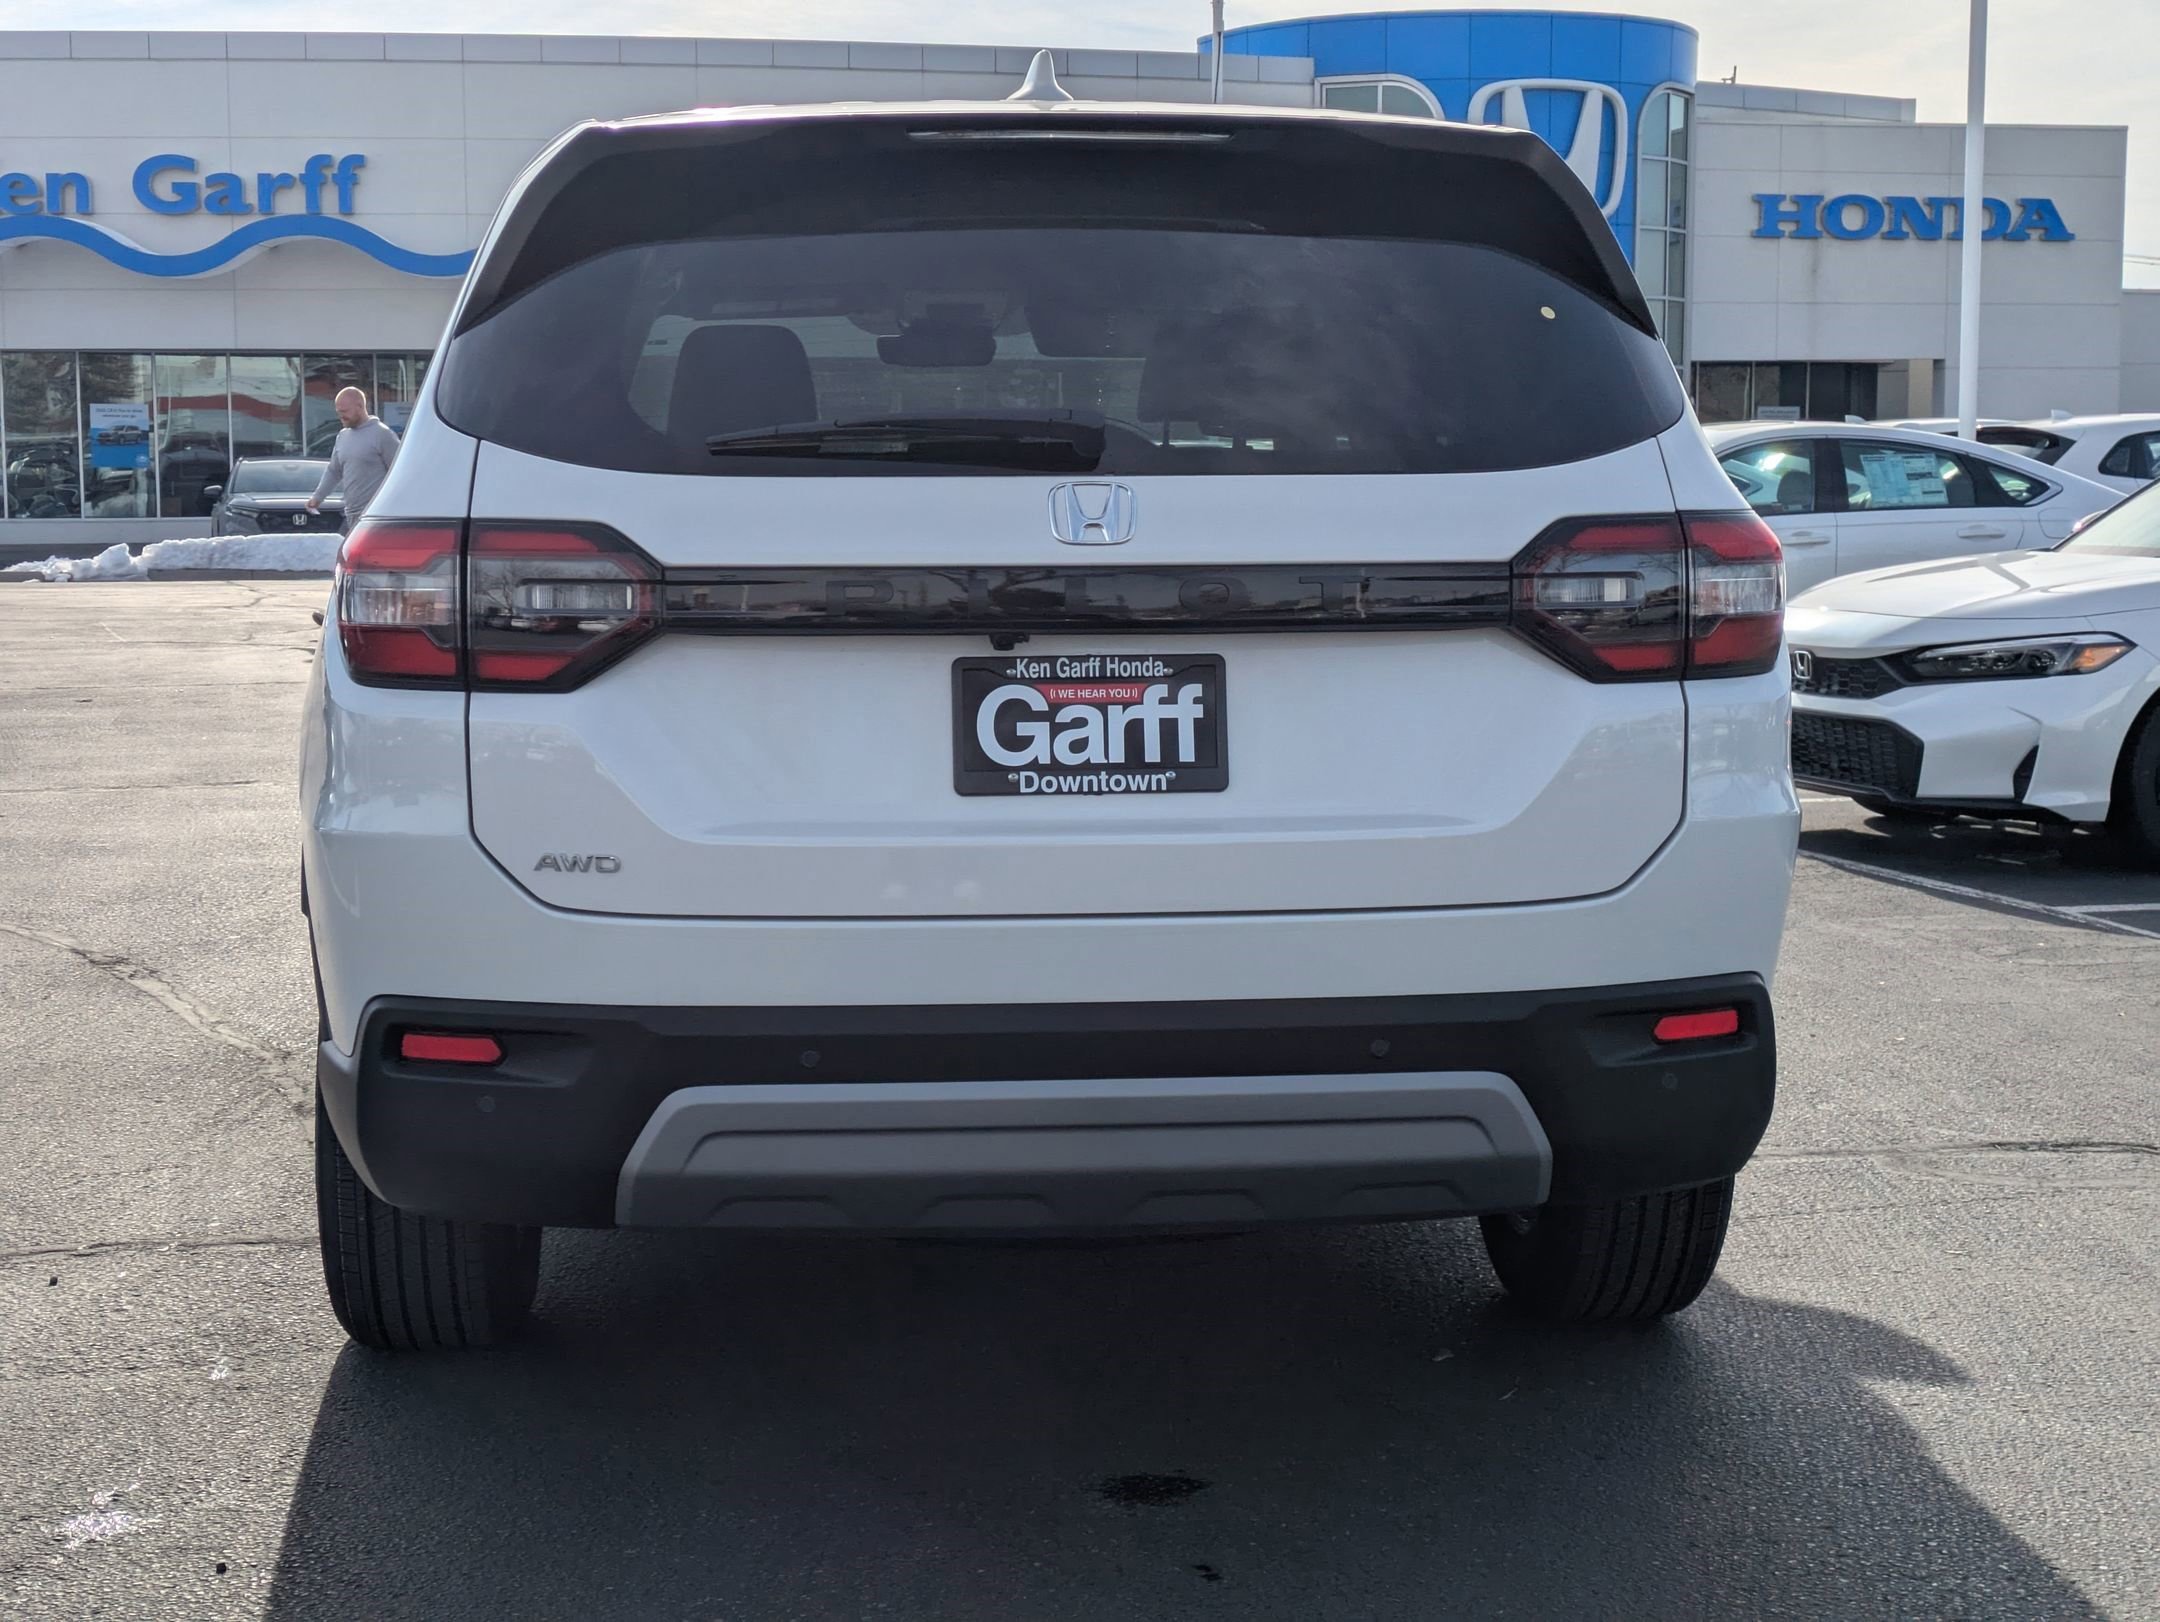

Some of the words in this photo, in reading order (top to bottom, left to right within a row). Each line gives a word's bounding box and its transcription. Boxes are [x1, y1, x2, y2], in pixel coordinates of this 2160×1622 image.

[132, 153, 367, 216] Garff
[1751, 193, 2076, 241] HONDA
[825, 575, 1366, 618] PILOT
[1016, 658, 1050, 678] Ken
[1056, 657, 1100, 678] Garff
[1106, 656, 1164, 677] Honda
[1058, 689, 1076, 699] WE
[1077, 689, 1107, 698] HEAR
[1108, 688, 1131, 698] YOU
[976, 683, 1204, 767] Garff
[1019, 771, 1168, 793] Downtown
[533, 852, 622, 874] AWD
